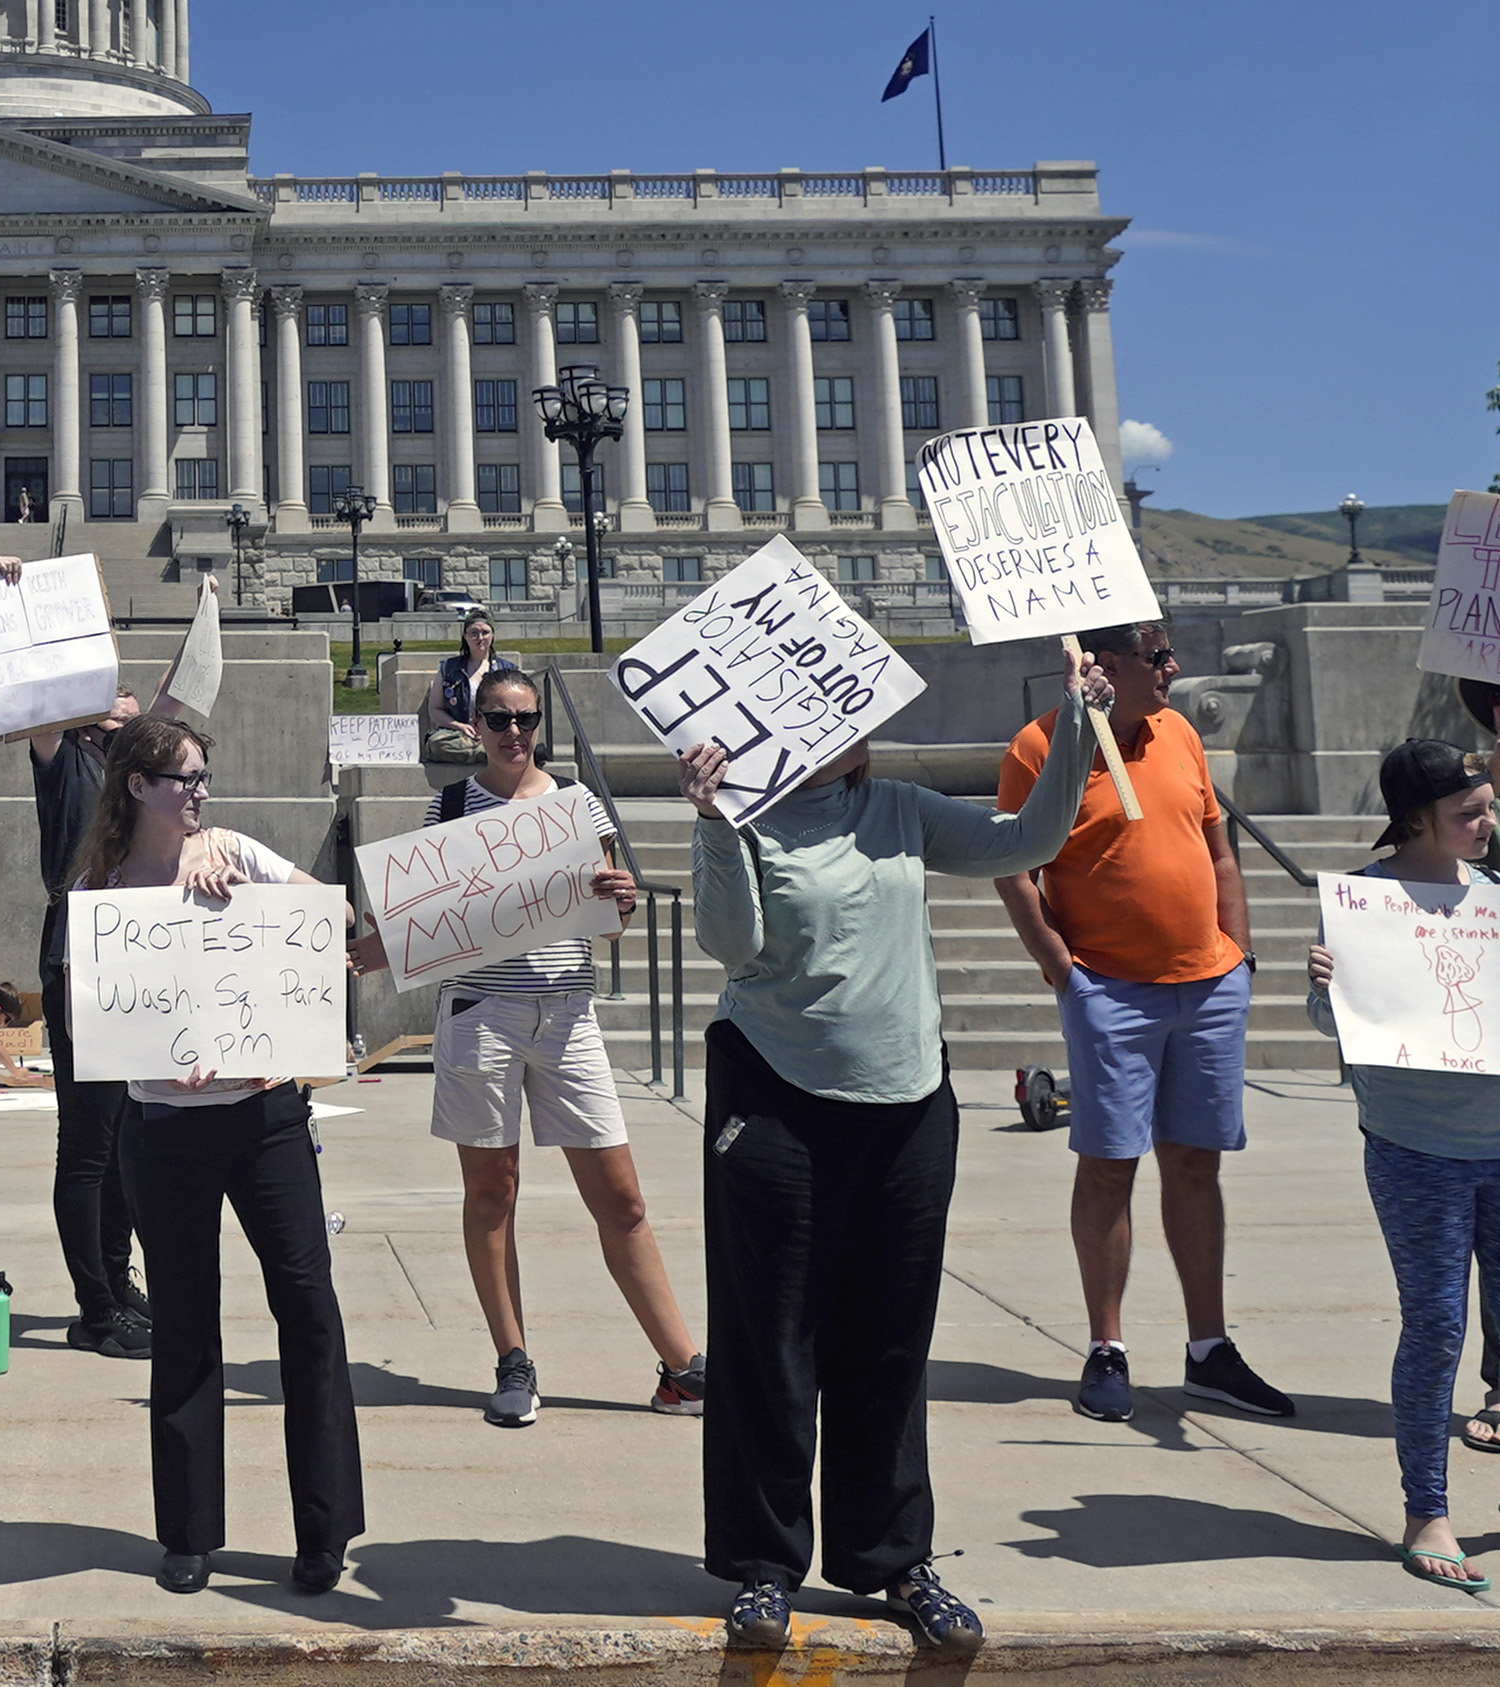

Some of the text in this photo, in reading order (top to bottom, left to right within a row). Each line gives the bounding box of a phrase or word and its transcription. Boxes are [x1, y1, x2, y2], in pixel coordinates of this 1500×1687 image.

[922, 423, 1082, 492] NOT EVERY
[934, 470, 1118, 553] EJACULATION
[956, 539, 1102, 591] DESERVES A
[785, 562, 891, 684] VAGINA
[987, 575, 1112, 621] NAME
[731, 582, 874, 716] OUT OF MY
[330, 717, 366, 736] KEEP
[367, 729, 400, 748] OUT
[618, 649, 807, 824] KEEP
[384, 798, 579, 911] MY BODY
[1335, 882, 1368, 912] the
[285, 908, 333, 952] 2.0
[404, 901, 475, 974] MY
[1414, 925, 1437, 940] are
[96, 968, 334, 1030] Wash. Sq. Park
[170, 1027, 199, 1066] 6
[1396, 1042, 1412, 1067] A
[1440, 1050, 1487, 1073] toxic
